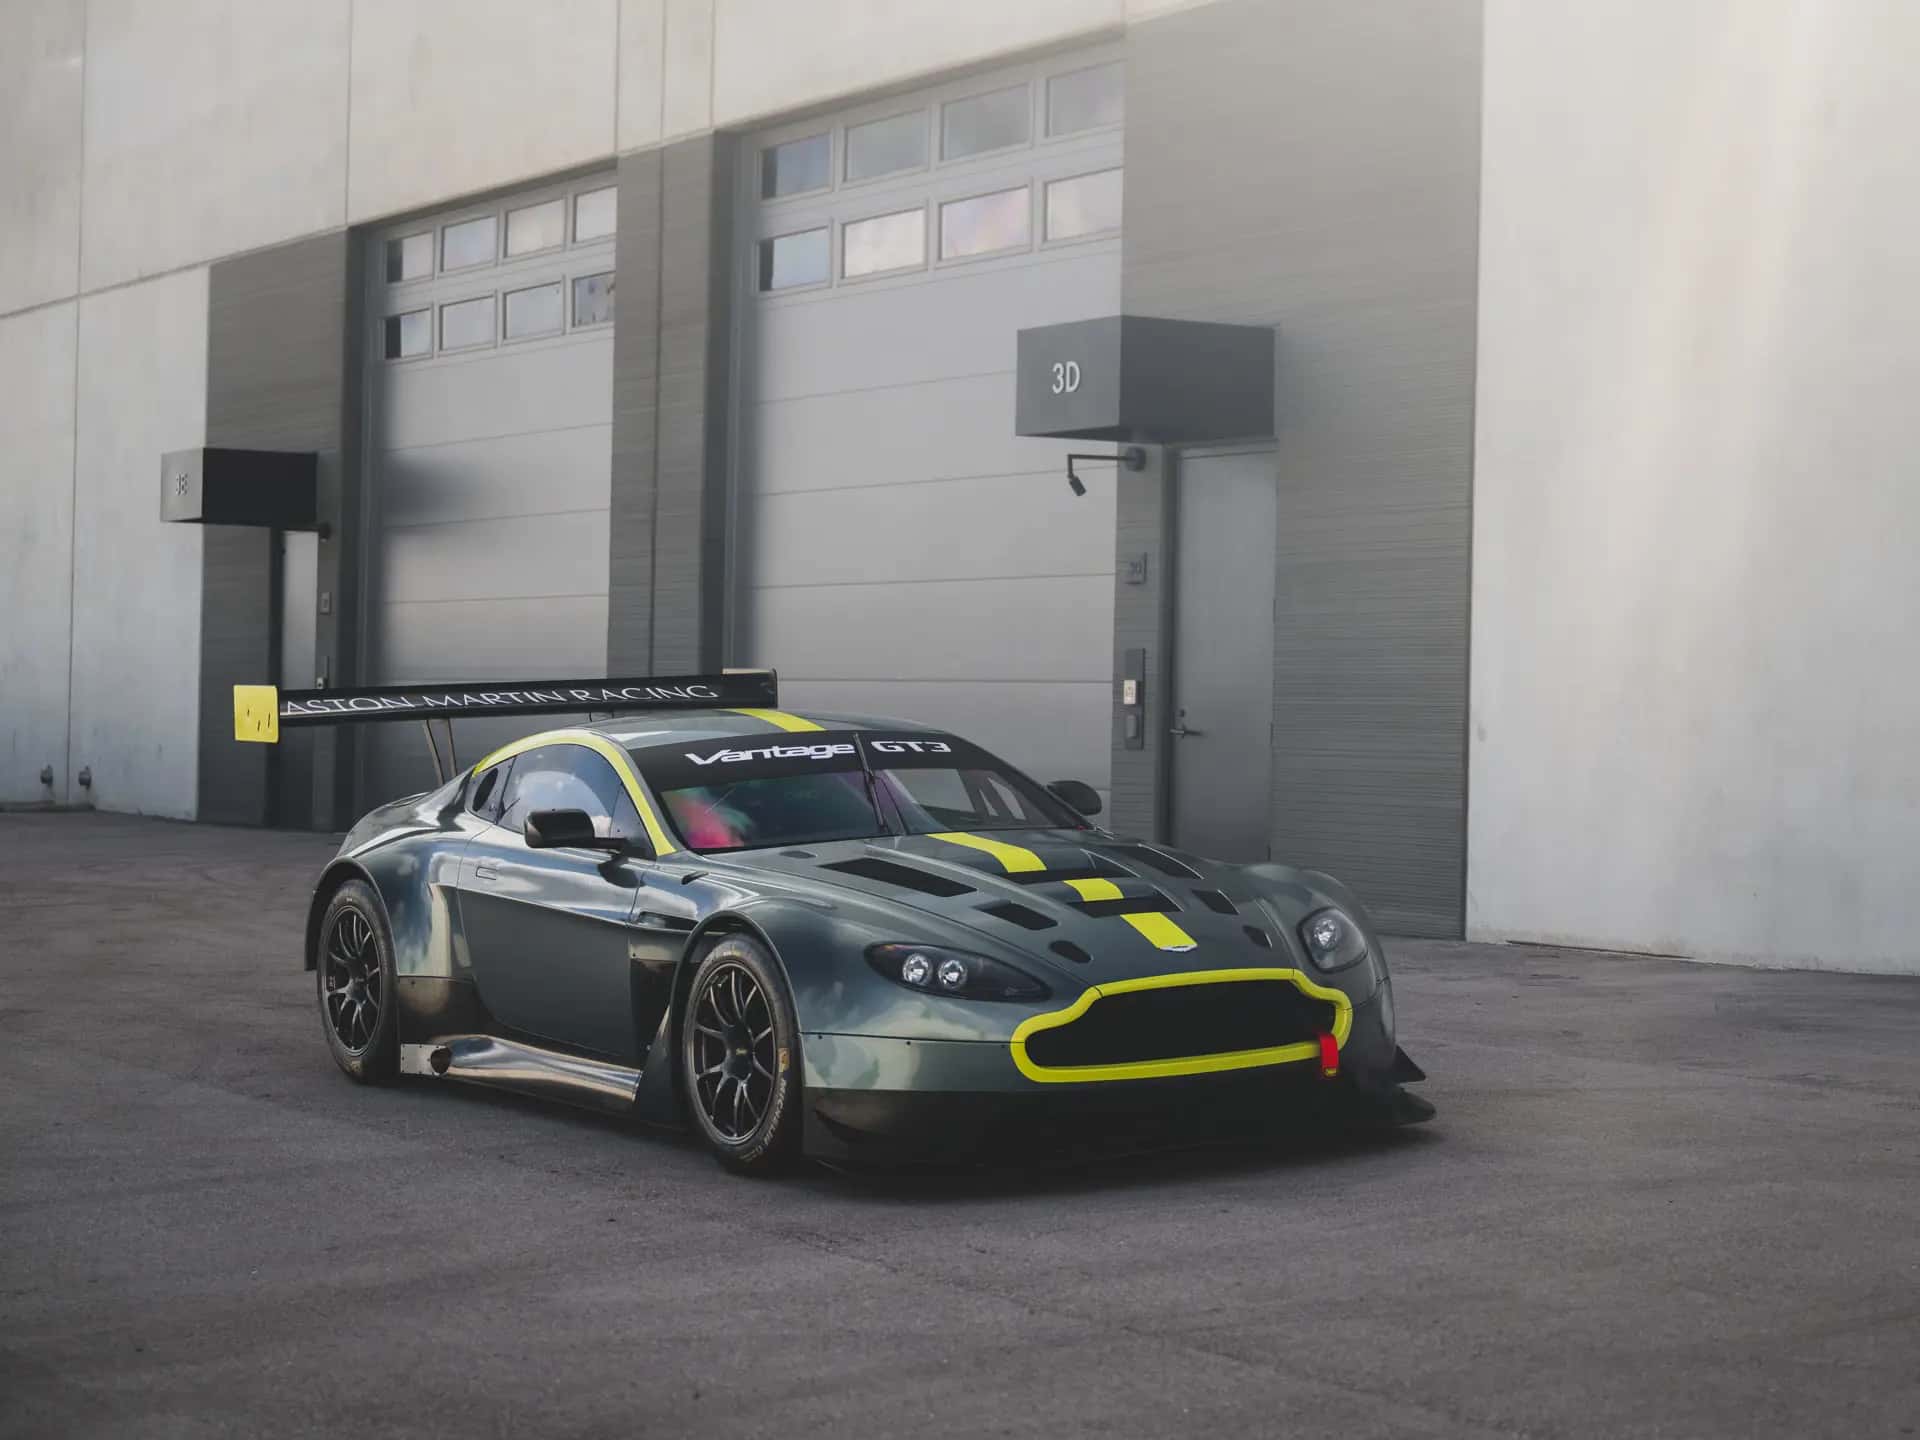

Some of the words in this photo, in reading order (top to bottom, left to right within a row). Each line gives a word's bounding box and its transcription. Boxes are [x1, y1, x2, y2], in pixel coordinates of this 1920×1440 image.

[1052, 361, 1081, 394] 3D
[287, 697, 415, 714] ASTON
[422, 690, 567, 707] MARTIN
[569, 685, 718, 701] RACING
[685, 743, 856, 765] Vantage
[871, 741, 952, 752] GT3
